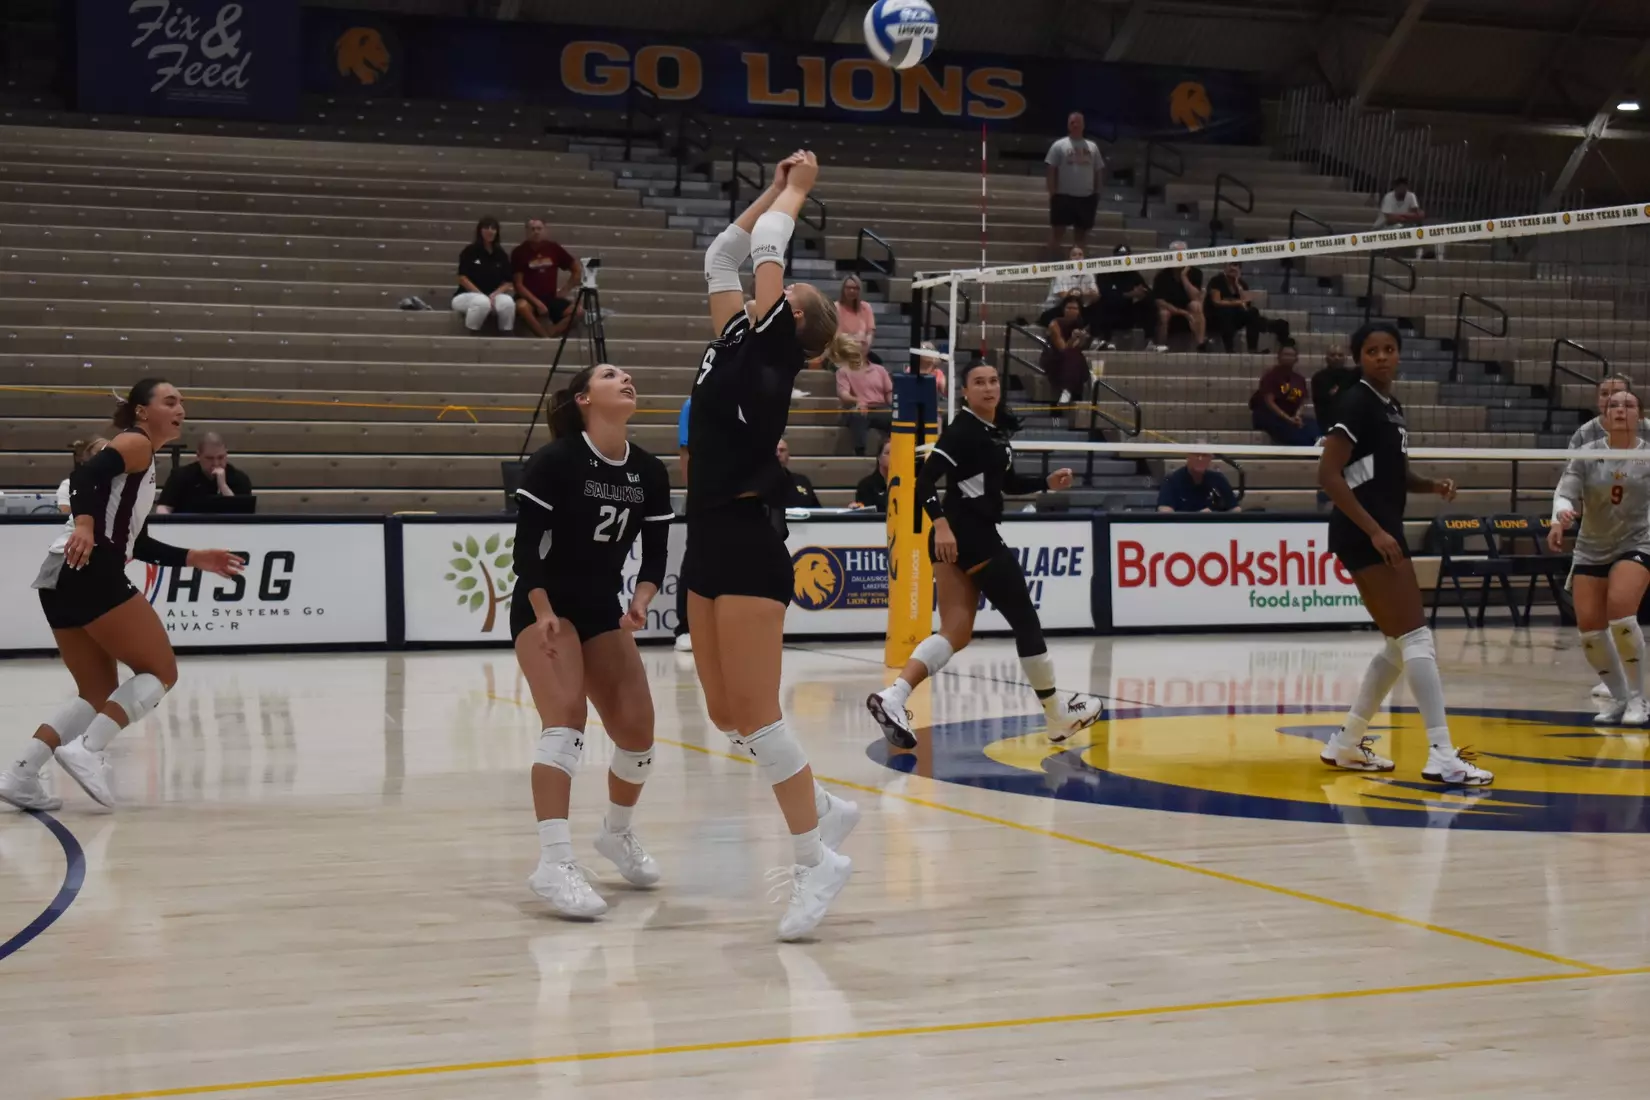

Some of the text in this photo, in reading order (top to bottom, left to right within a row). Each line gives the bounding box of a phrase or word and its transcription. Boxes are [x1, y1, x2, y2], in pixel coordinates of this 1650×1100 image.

[129, 0, 243, 59] Fix &
[148, 44, 252, 92] Feed
[560, 40, 1027, 119] GO LIONS
[1577, 212, 1594, 222] EAST
[1596, 210, 1620, 220] TEXAS
[1500, 219, 1516, 229] EAST
[1518, 217, 1541, 227] TEXAS
[1429, 228, 1444, 237] EAST
[1446, 225, 1466, 235] TEXAS
[1362, 235, 1376, 243] EAST
[1378, 232, 1397, 241] TEXAS
[1300, 241, 1313, 249] EAST
[1315, 239, 1332, 247] TEXAS
[584, 480, 644, 503] SALUKS
[1611, 485, 1623, 505] 9
[593, 505, 630, 542] 21
[1445, 519, 1480, 529] LIONS
[1494, 519, 1528, 529] LIONS
[845, 550, 888, 572] Hilt
[167, 607, 325, 617] ALL SYSTEMS GO
[167, 622, 240, 631] HVAC-R
